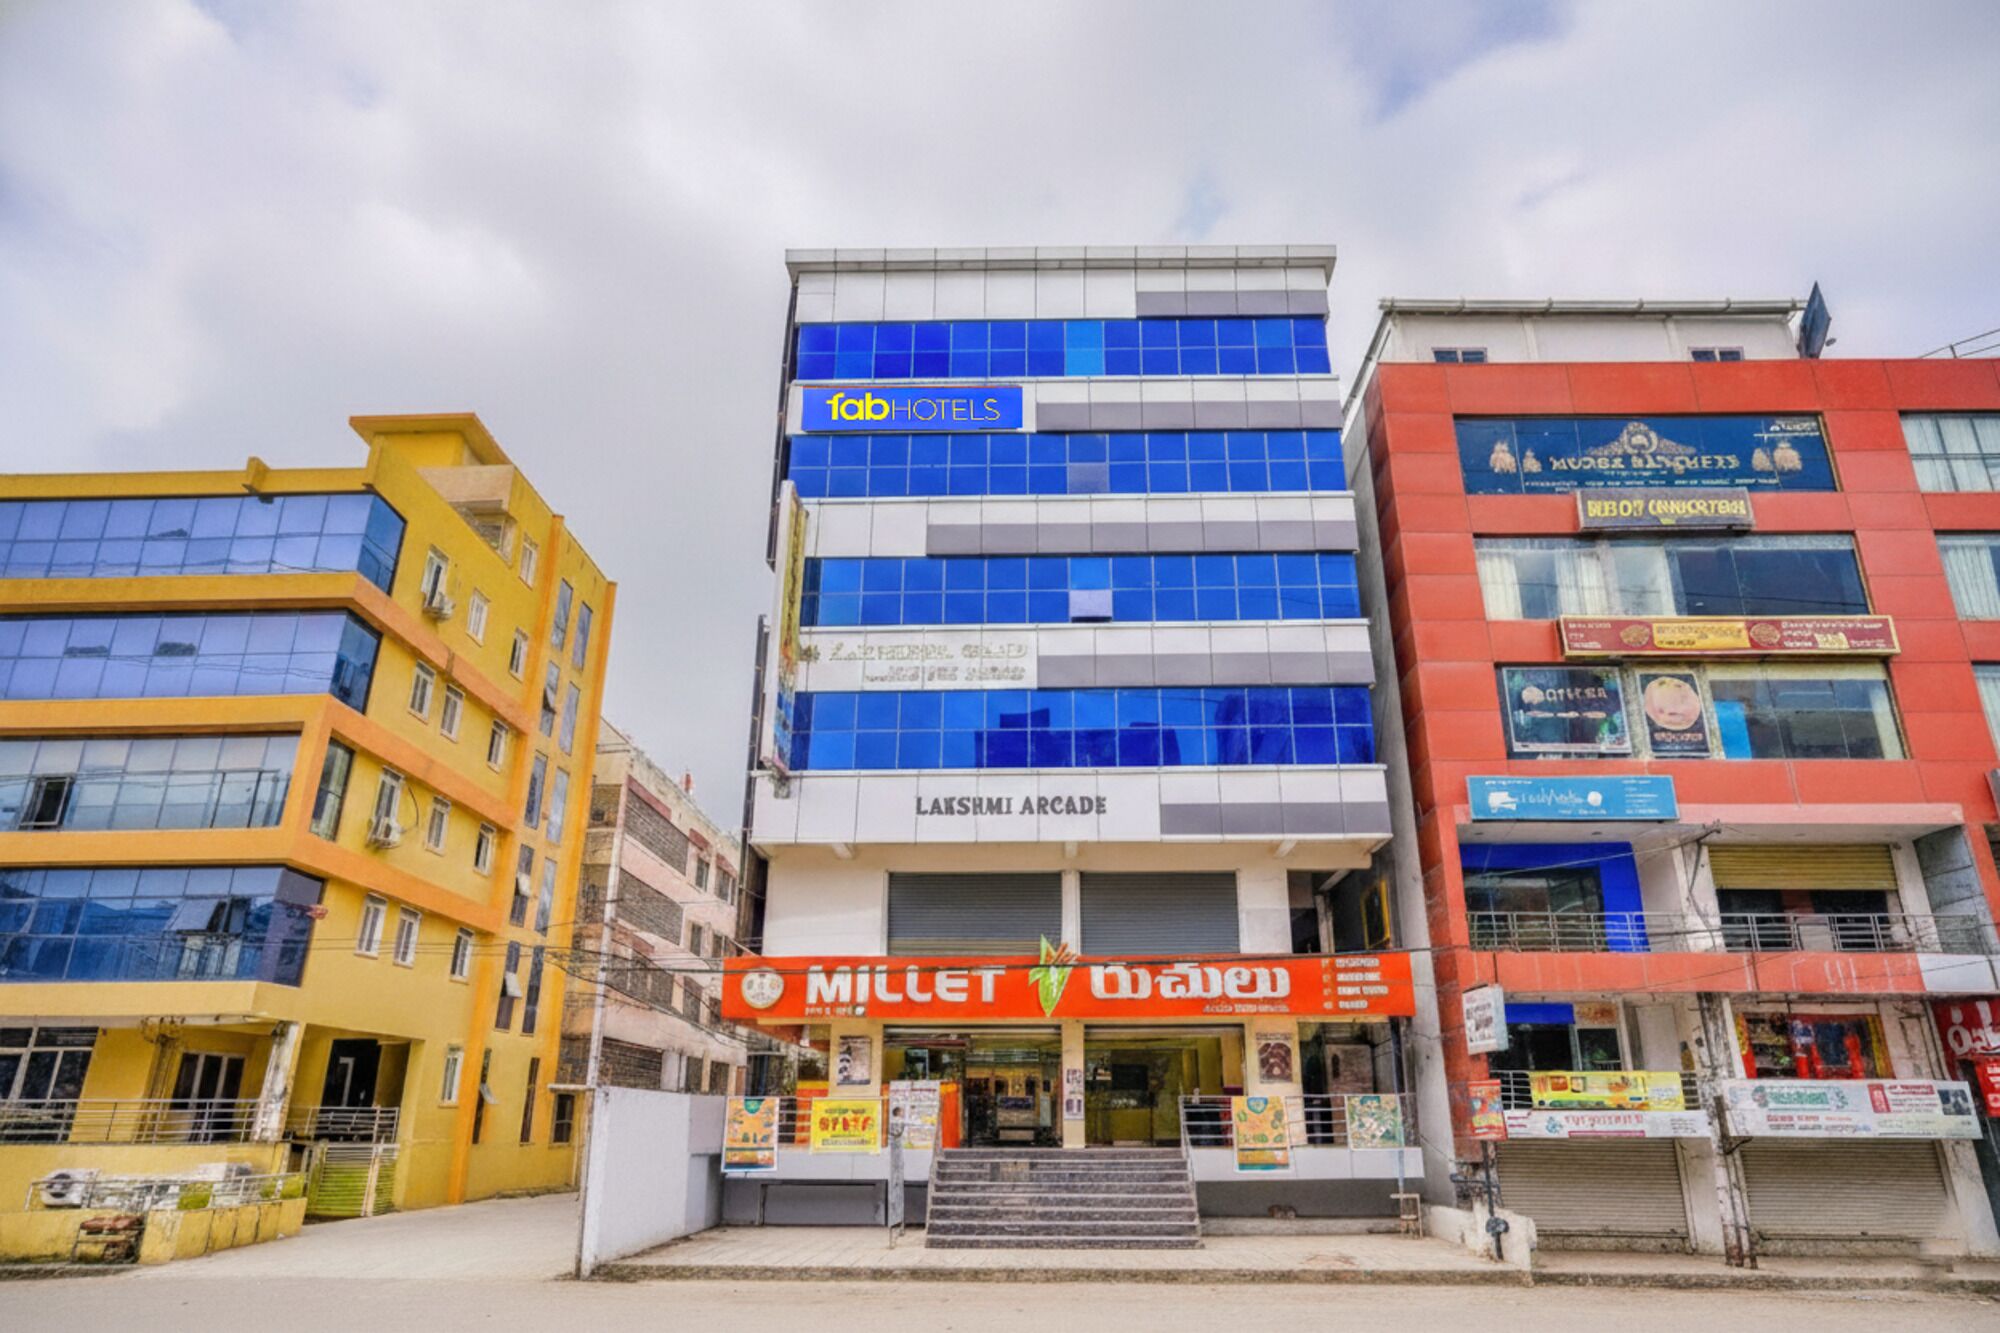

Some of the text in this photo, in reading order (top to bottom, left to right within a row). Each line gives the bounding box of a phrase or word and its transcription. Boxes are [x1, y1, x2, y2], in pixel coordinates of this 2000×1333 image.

[826, 392, 1001, 421] fabHOTELS
[917, 796, 1106, 816] LAKSHMI ARCADE
[806, 965, 1006, 1004] MILLET
